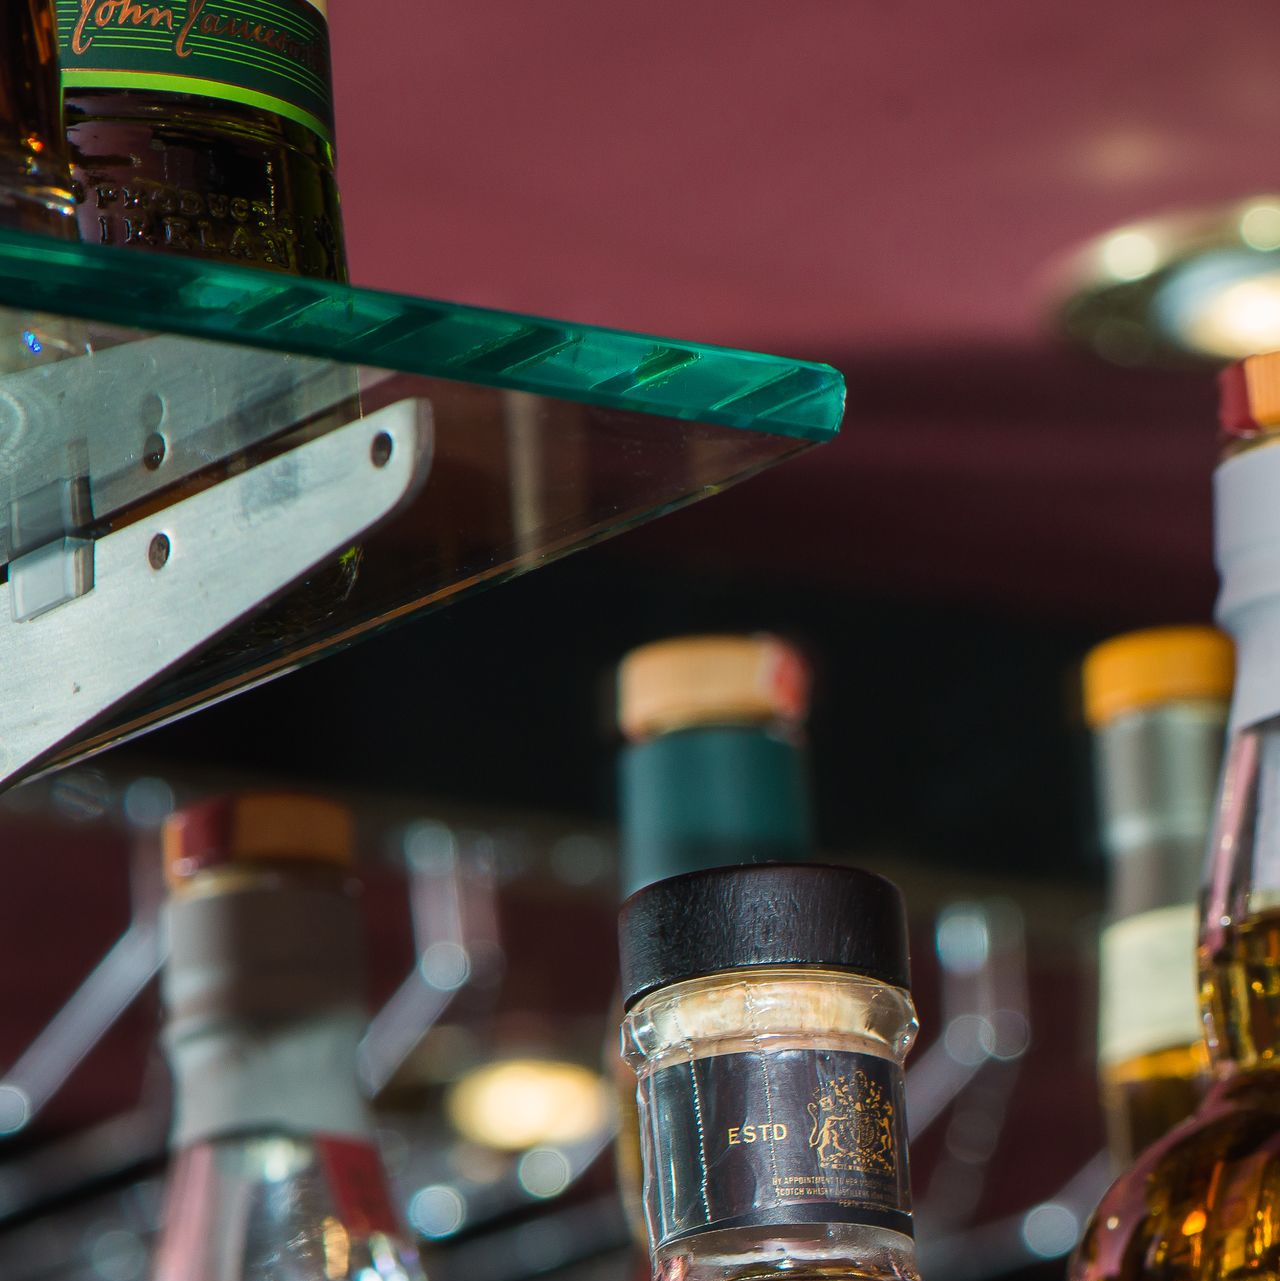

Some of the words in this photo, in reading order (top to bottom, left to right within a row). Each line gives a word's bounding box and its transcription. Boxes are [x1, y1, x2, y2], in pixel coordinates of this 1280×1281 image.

[727, 1123, 788, 1146] ESTD
[784, 1175, 834, 1186] APPOINTMENT
[775, 1186, 804, 1198] SCOTCH
